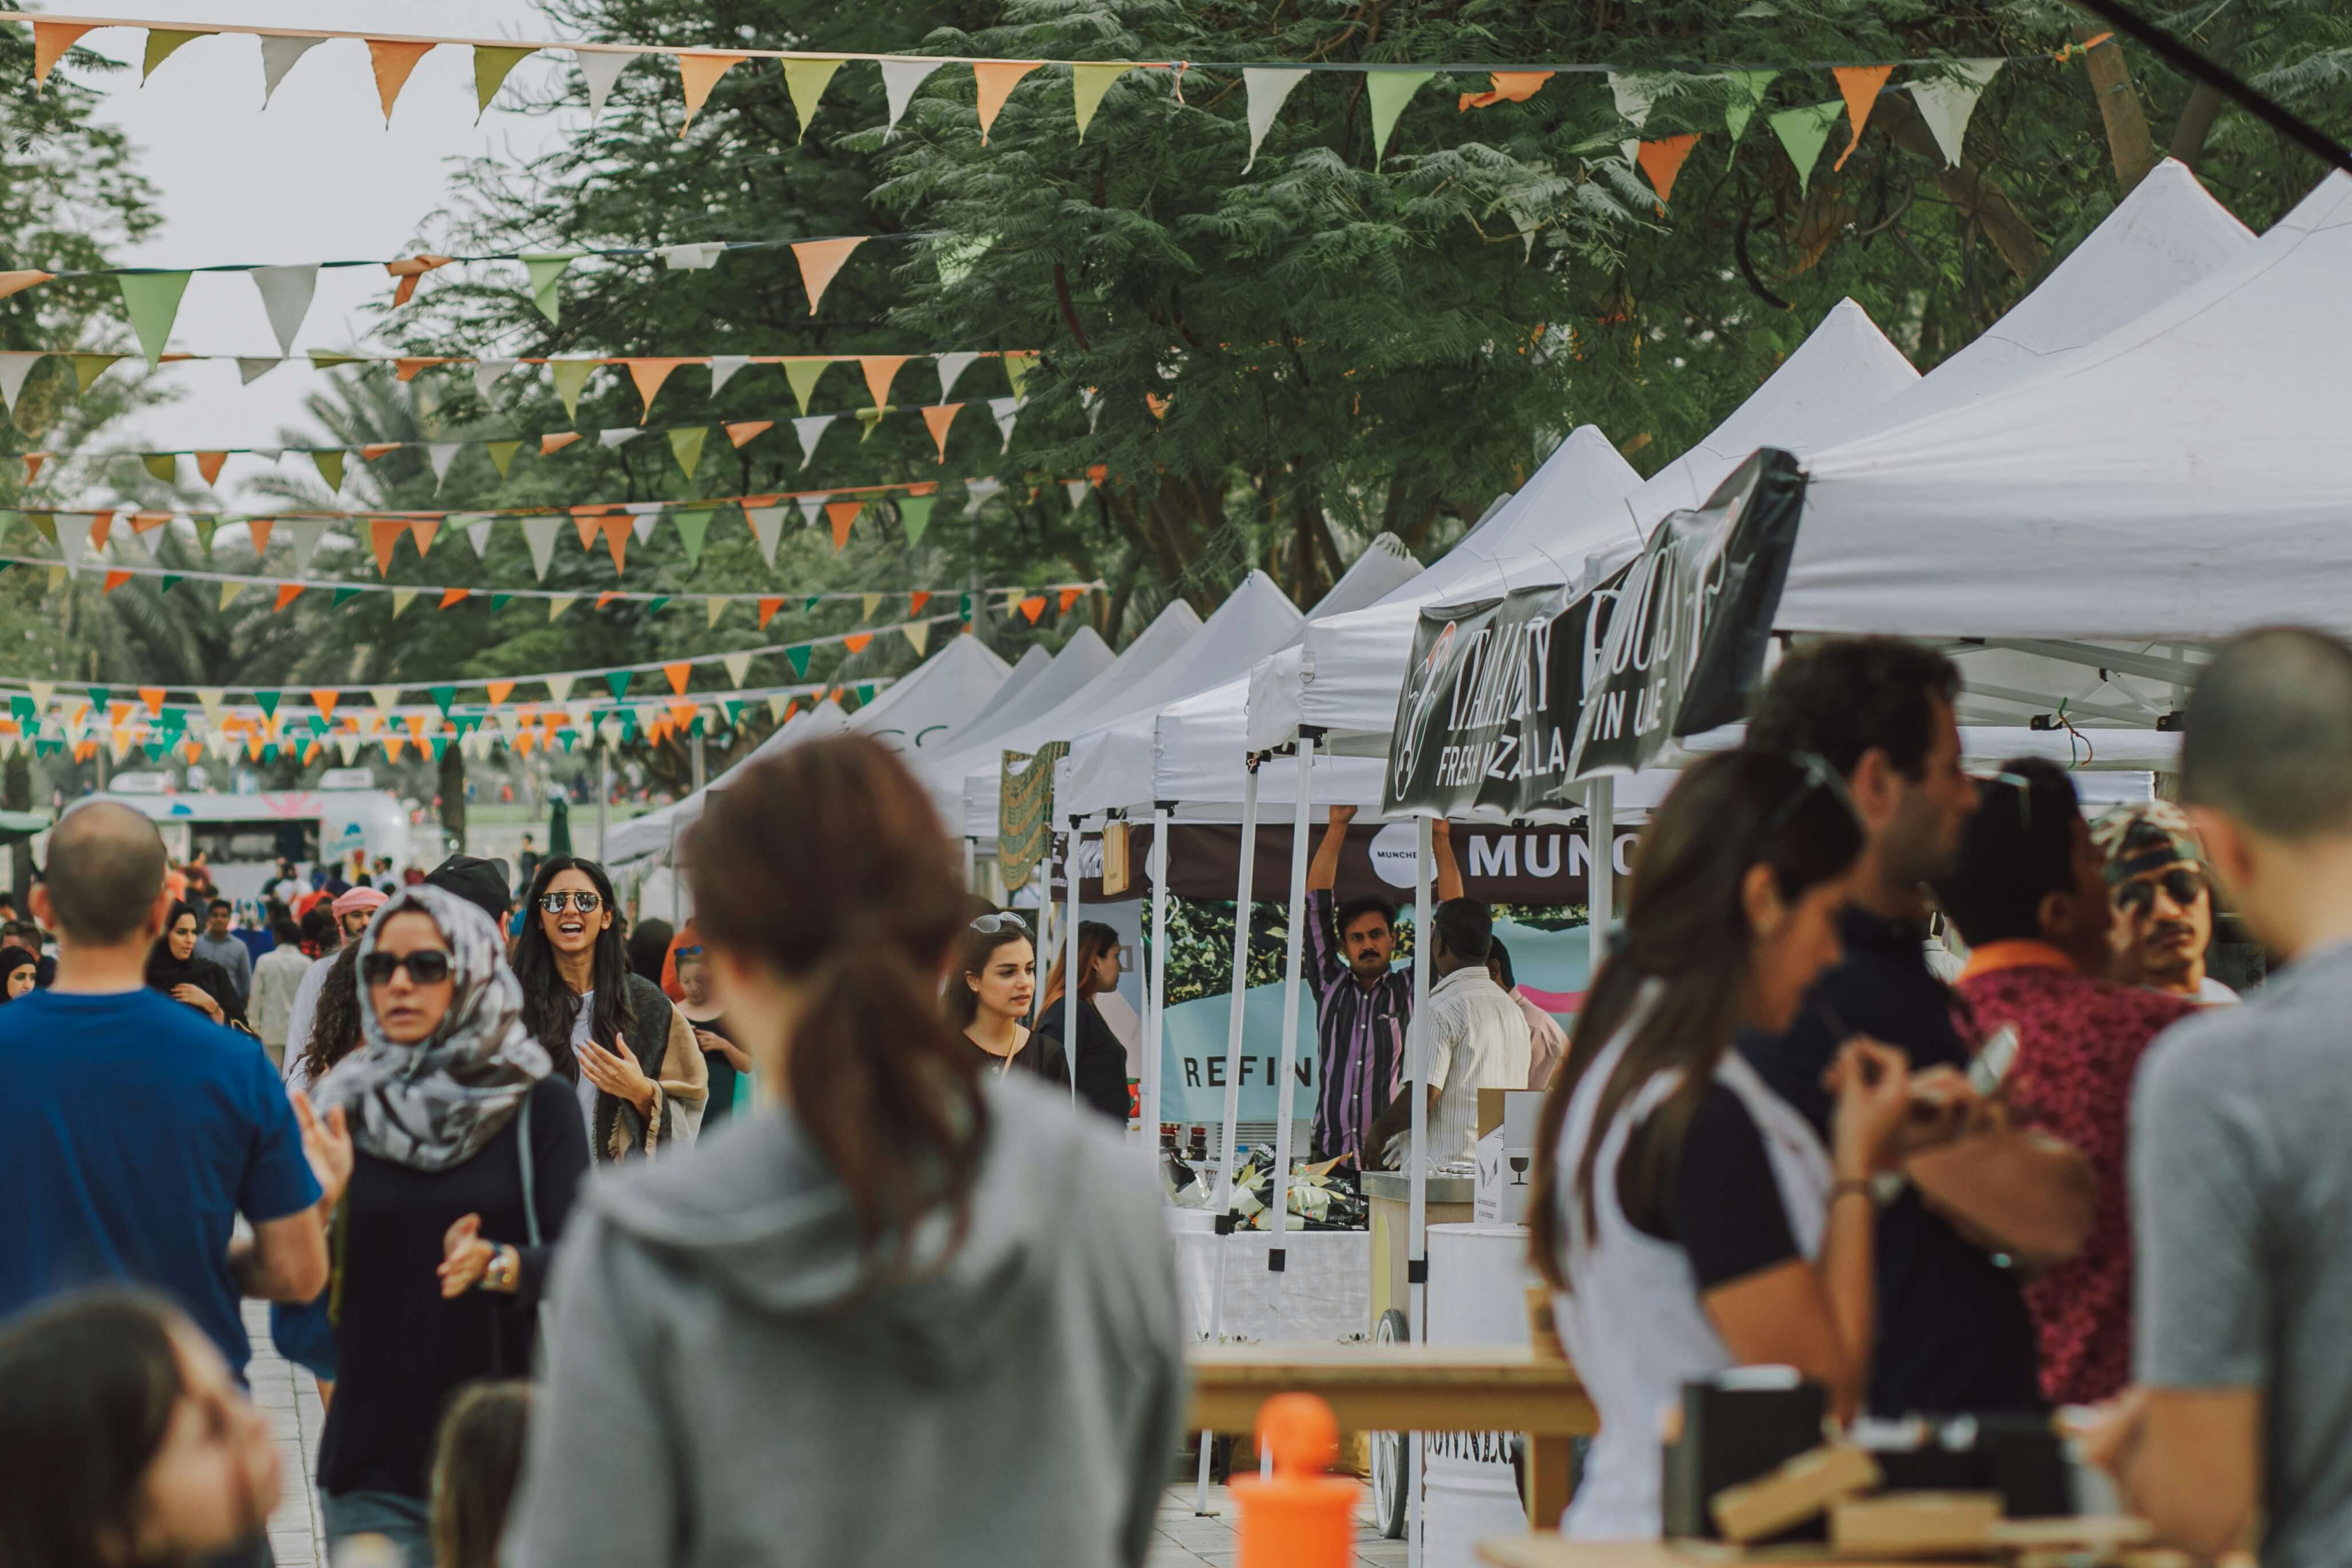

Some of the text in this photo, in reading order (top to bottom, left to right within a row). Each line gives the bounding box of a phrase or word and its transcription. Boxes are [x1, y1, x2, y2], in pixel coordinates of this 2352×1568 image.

[1436, 743, 1483, 786] FRESH
[1593, 690, 1626, 741] IN
[1377, 850, 1434, 859] MUNCHE
